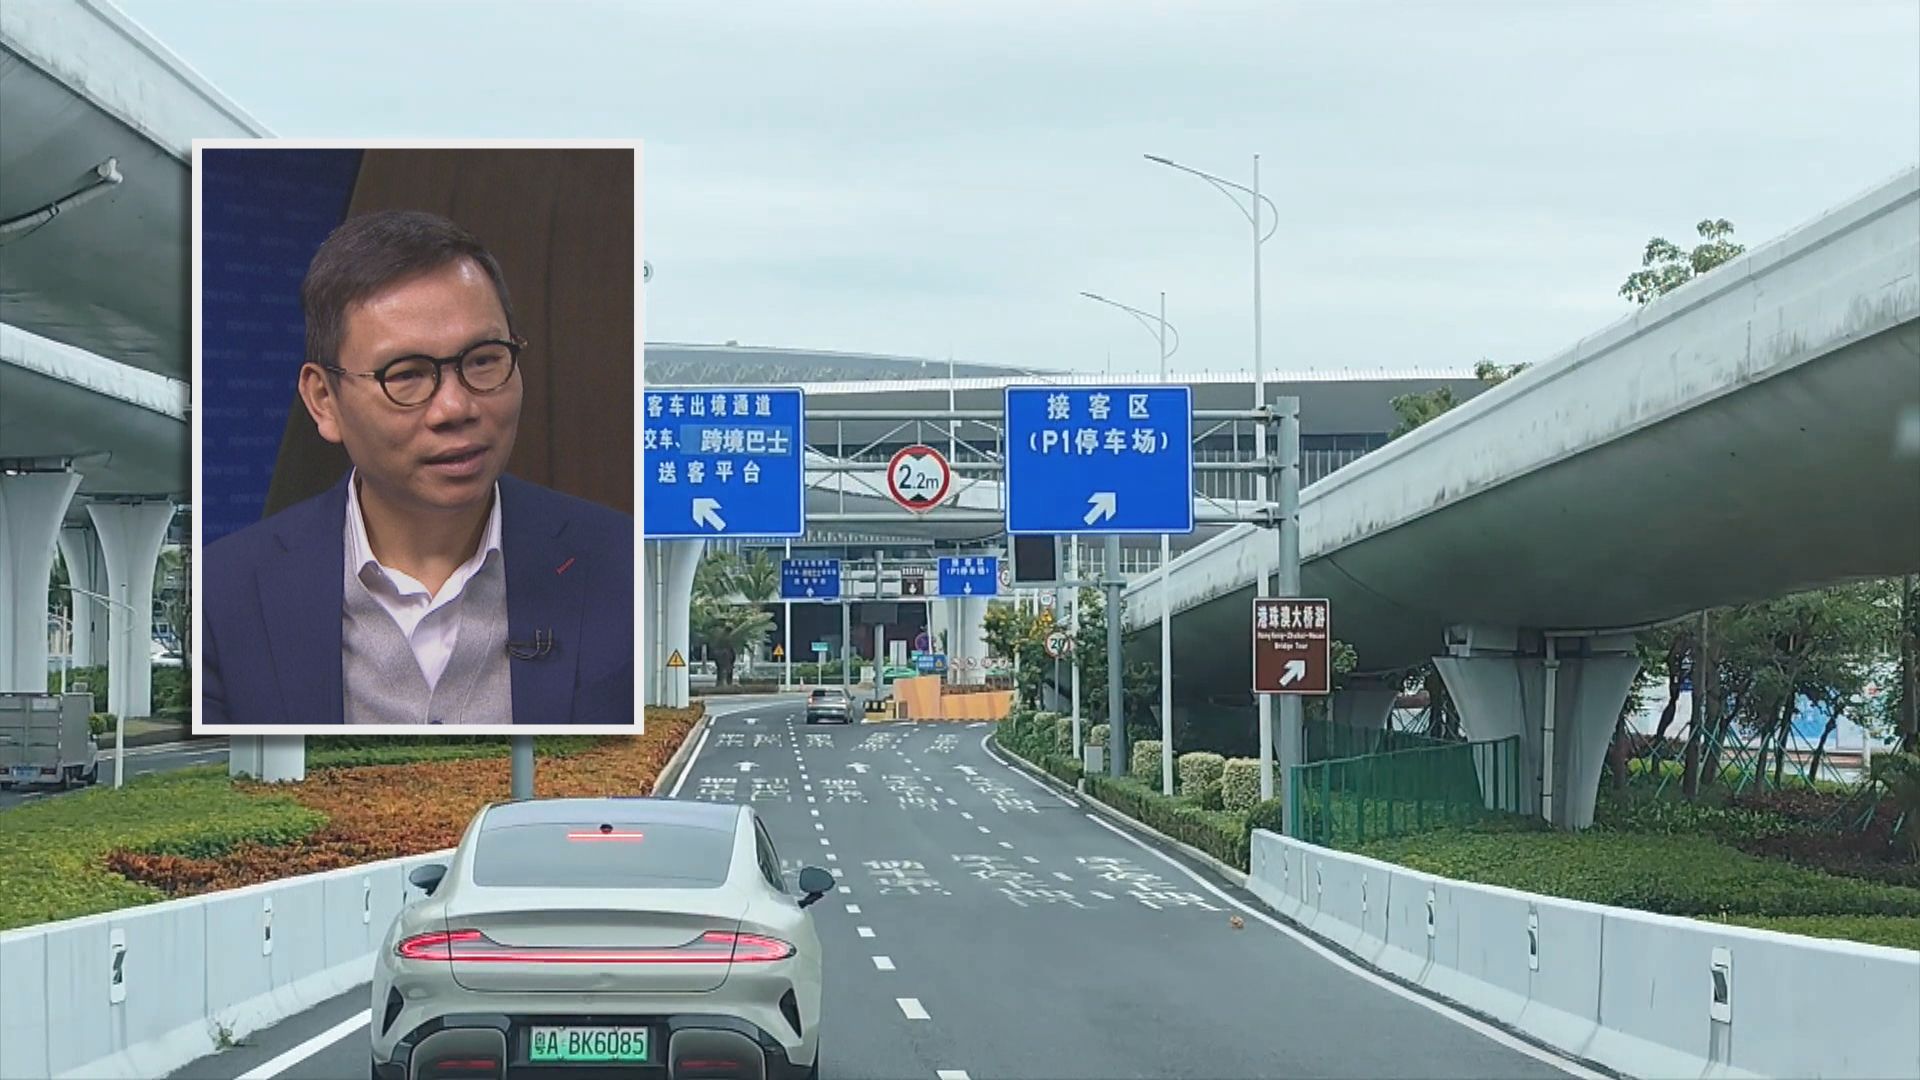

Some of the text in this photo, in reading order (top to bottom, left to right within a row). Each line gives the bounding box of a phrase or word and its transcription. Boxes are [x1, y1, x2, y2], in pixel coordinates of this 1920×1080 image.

[647, 394, 772, 417] 客车出境通道
[1047, 392, 1150, 420] 接客区
[700, 428, 789, 453] 跨境巴士
[658, 460, 761, 484] 送客平台
[899, 464, 939, 489] 2.2m
[1050, 638, 1065, 649] 20
[569, 1031, 644, 1055] BK6085
